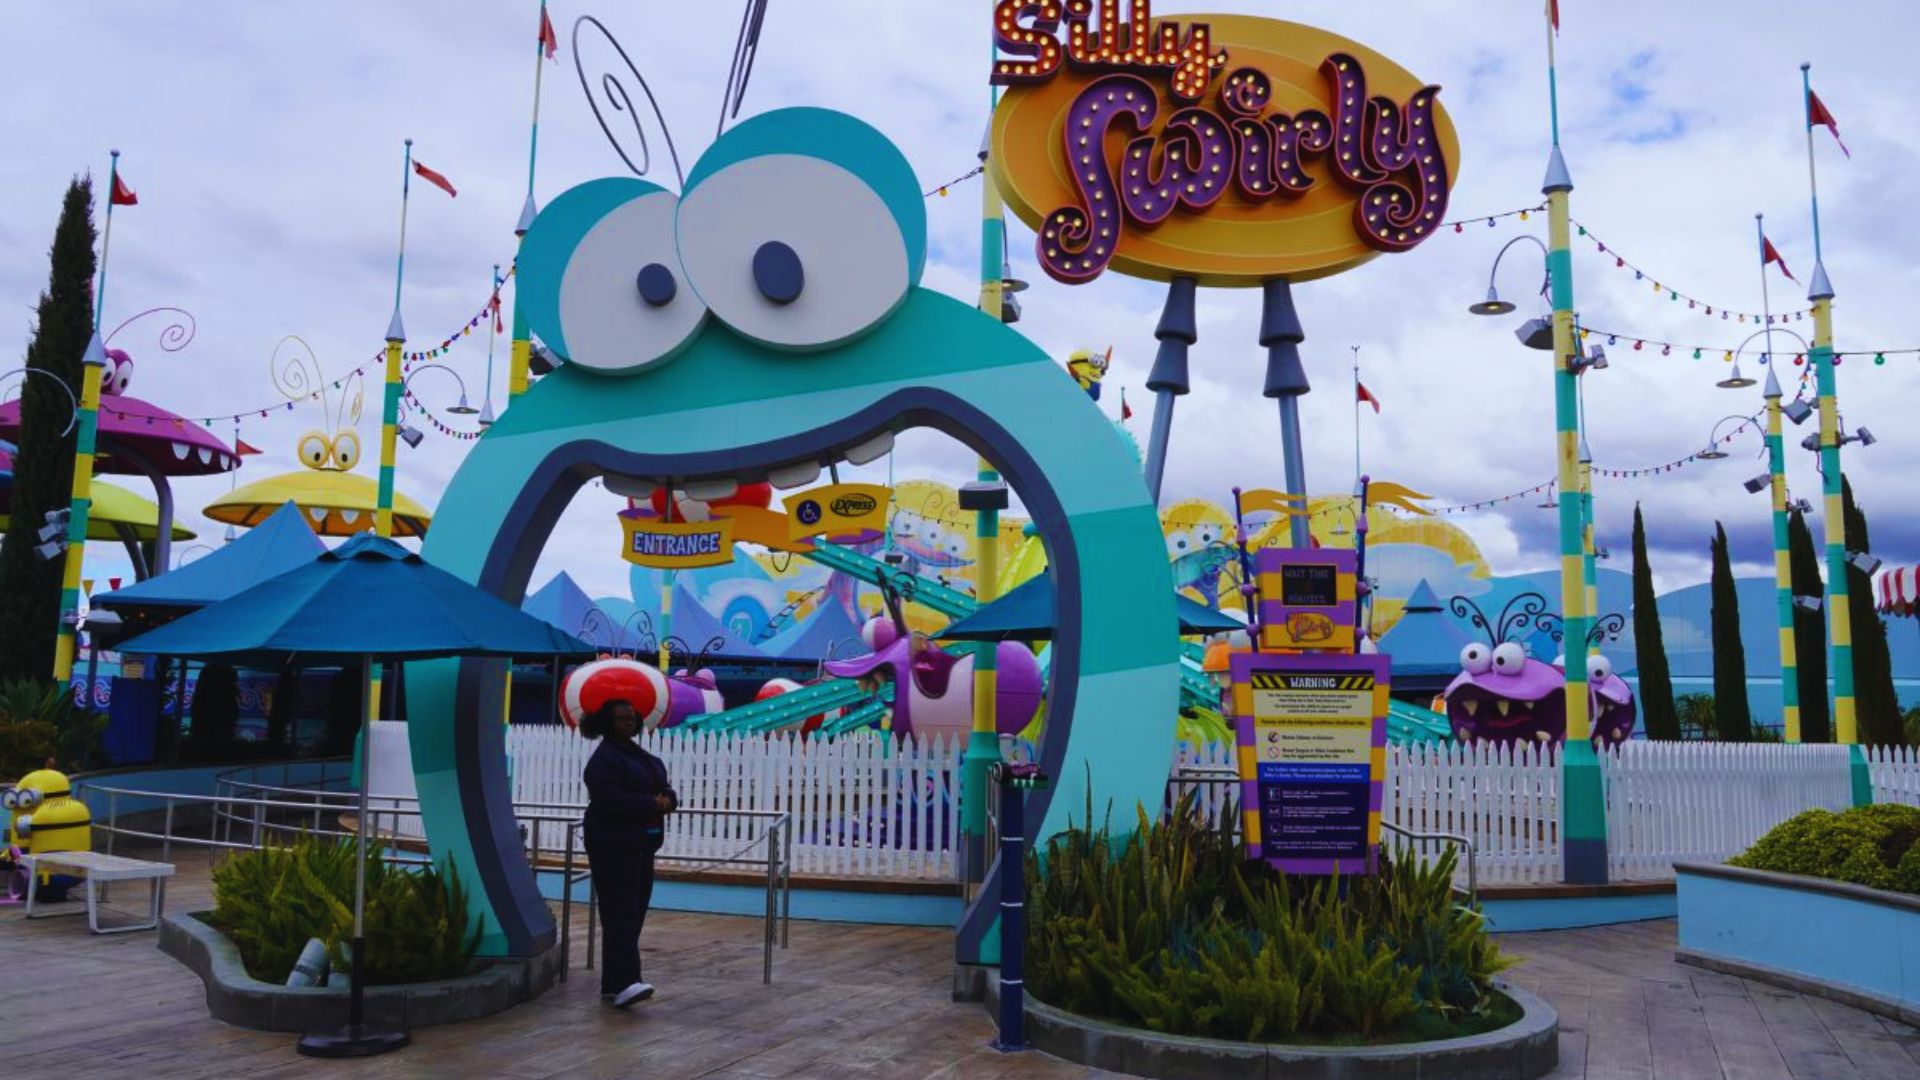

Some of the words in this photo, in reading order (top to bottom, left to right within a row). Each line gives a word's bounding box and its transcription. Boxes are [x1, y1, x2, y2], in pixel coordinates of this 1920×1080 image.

[989, 0, 1229, 104] Silly
[1036, 51, 1441, 284] Swirly
[835, 497, 873, 513] EXPRESS
[633, 532, 720, 555] ENTRANCE
[1284, 569, 1306, 579] WAIT
[1309, 569, 1329, 579] TIME
[1290, 677, 1337, 688] WARNING
